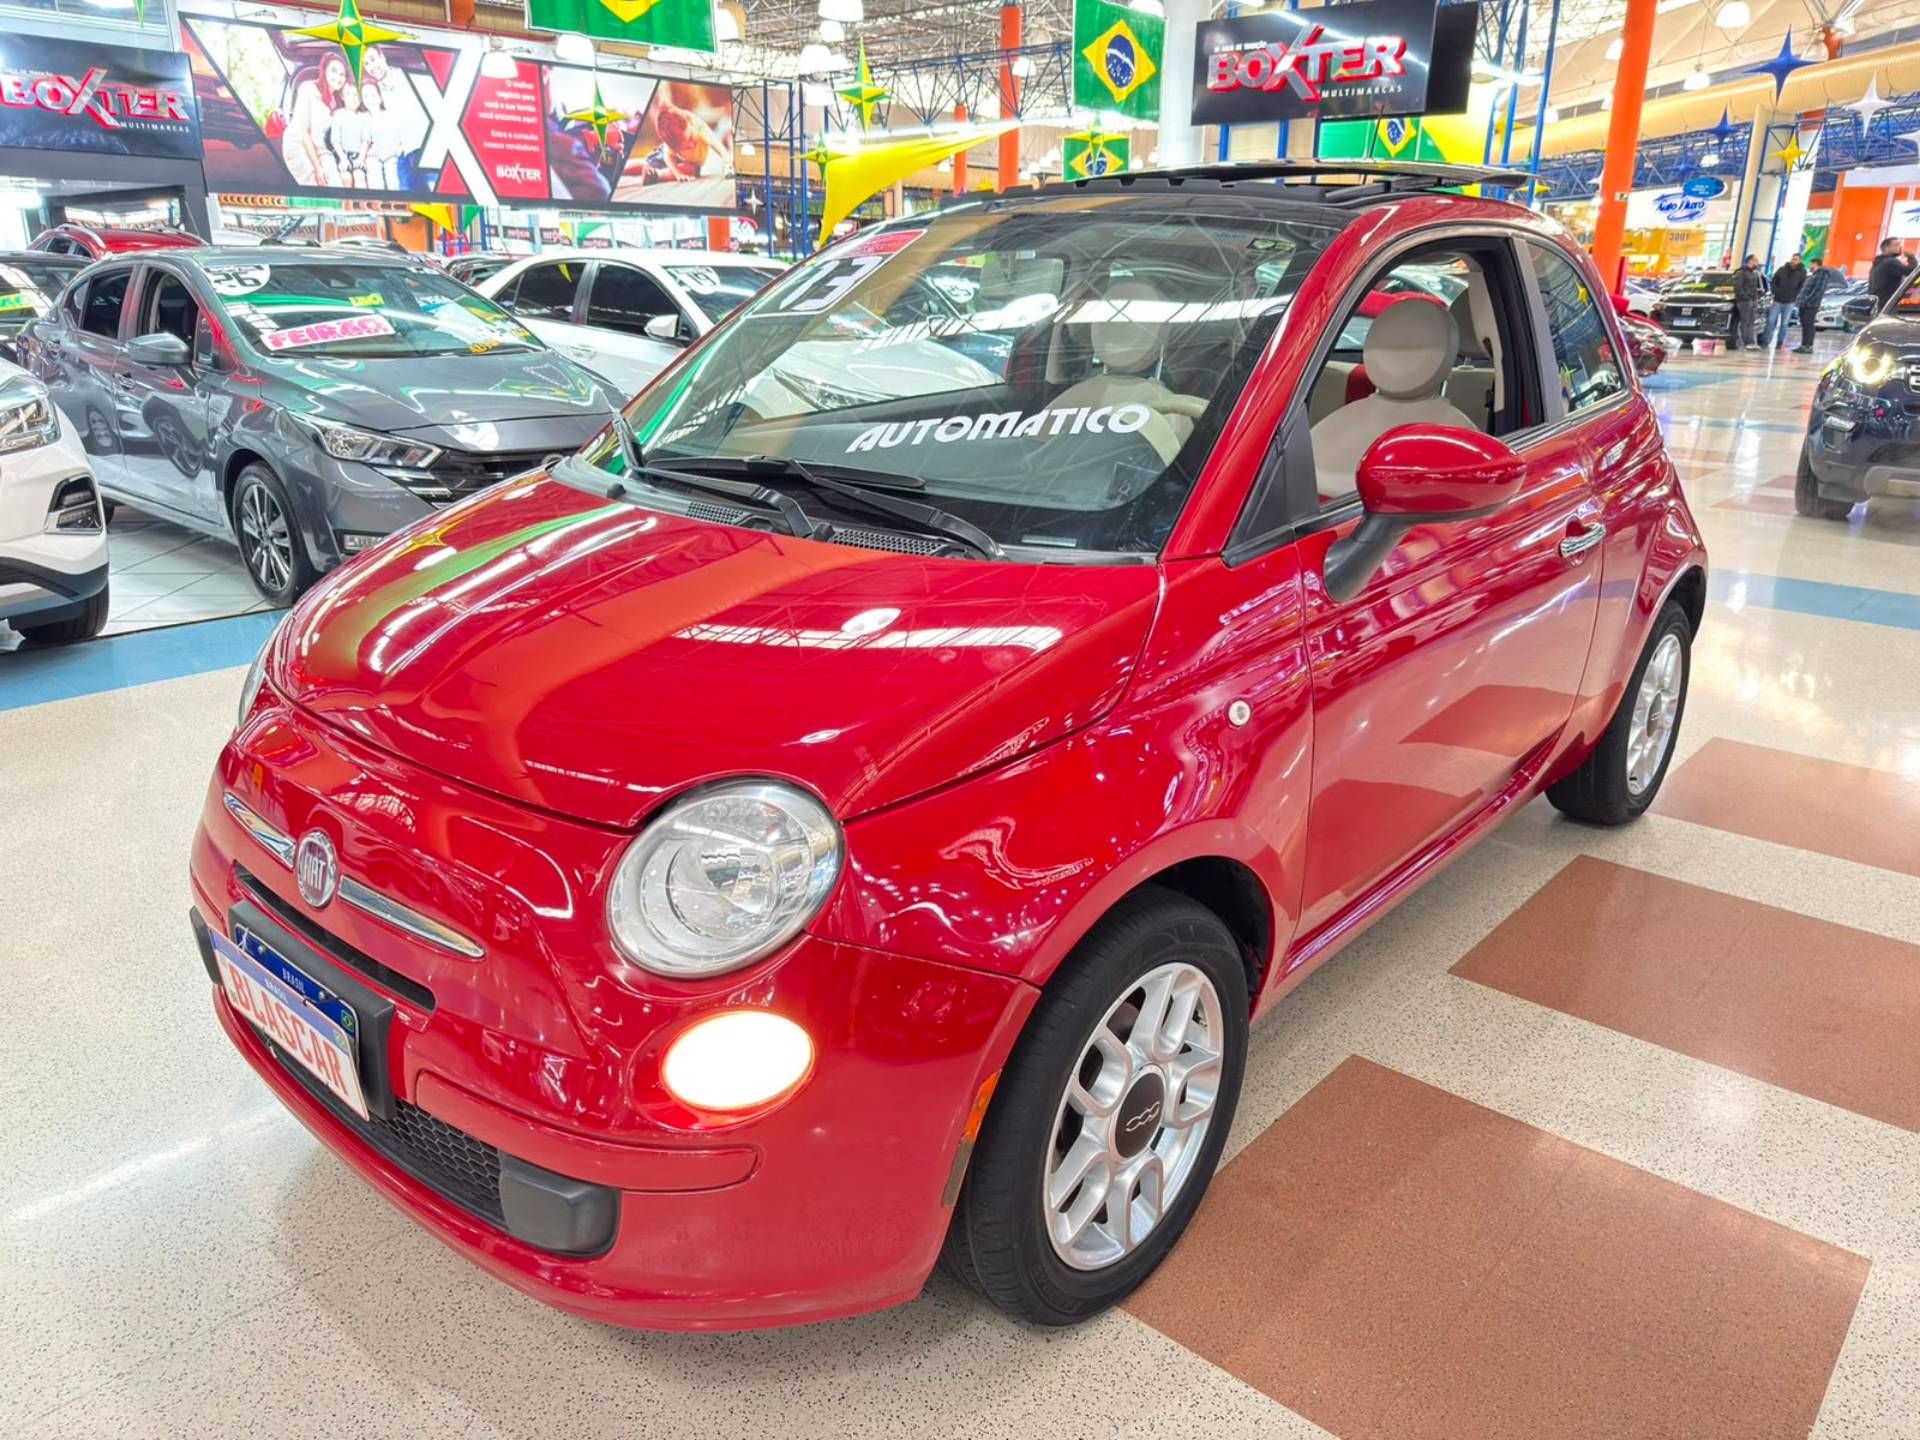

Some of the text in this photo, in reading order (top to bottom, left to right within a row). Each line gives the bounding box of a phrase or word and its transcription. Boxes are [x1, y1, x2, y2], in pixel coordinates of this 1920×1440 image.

[1207, 23, 1408, 102] BOXTER
[0, 67, 190, 130] BOXTER
[1320, 84, 1403, 98] MULTIMARCAS
[119, 121, 190, 133] MULTIMARCAS
[496, 162, 542, 184] BOXTER
[214, 271, 262, 288] 26
[778, 255, 883, 311] 13
[845, 403, 1151, 454] AUTOMATICO
[304, 851, 326, 891] FIAT
[282, 967, 306, 994] BRASIL
[228, 963, 349, 1097] BLASCAR
